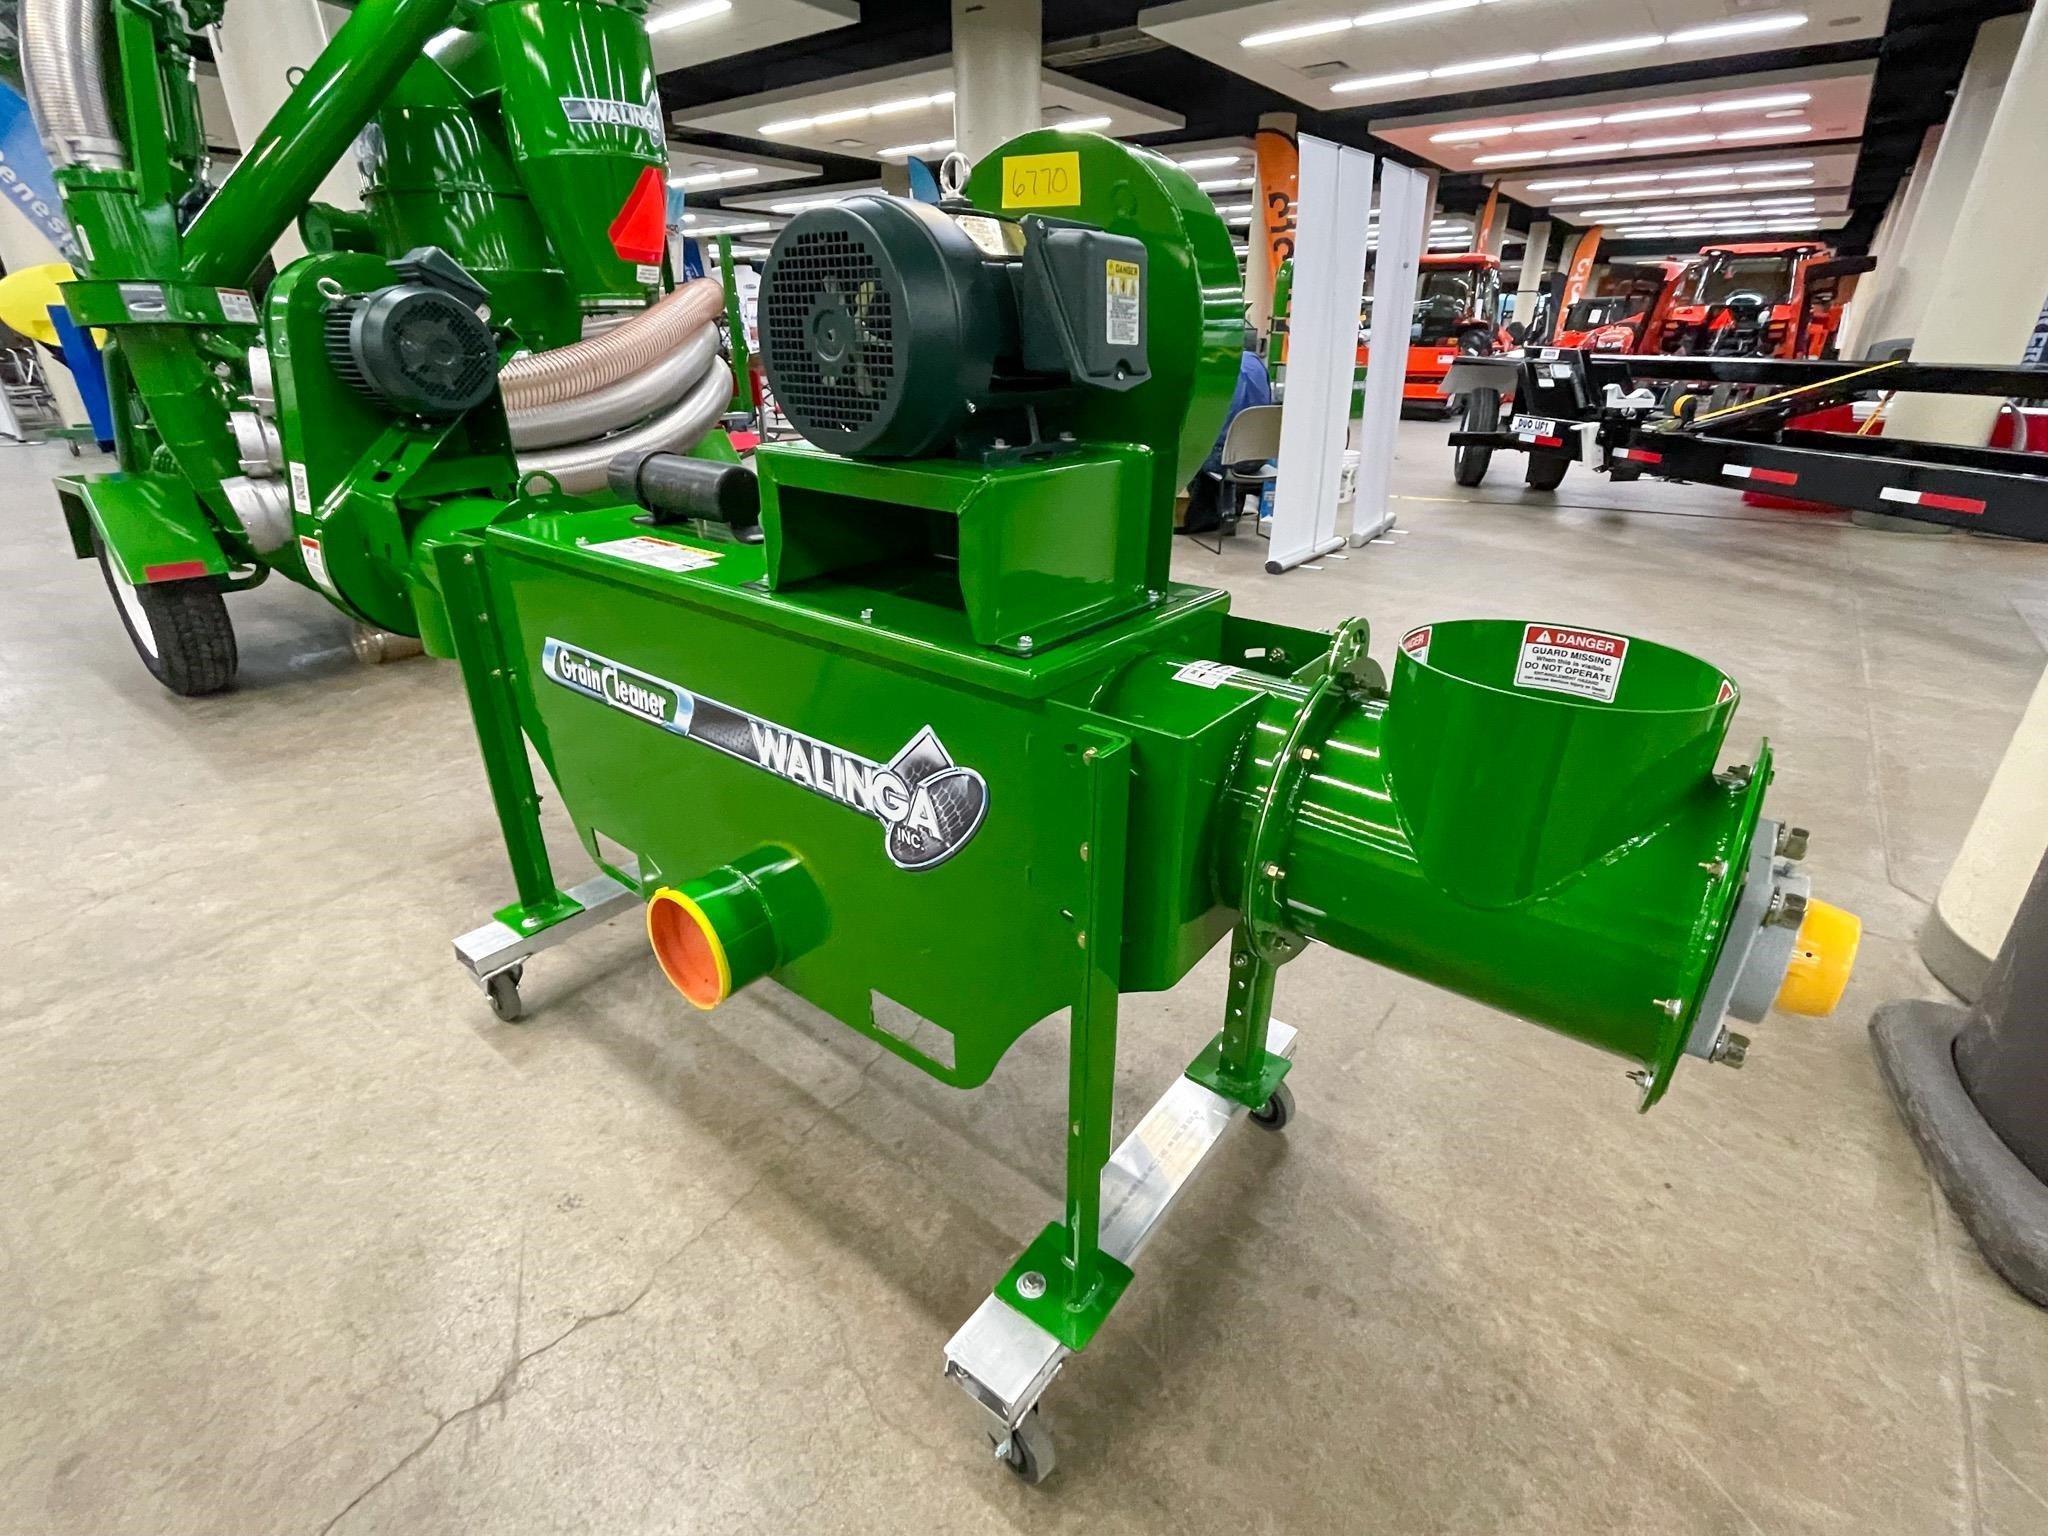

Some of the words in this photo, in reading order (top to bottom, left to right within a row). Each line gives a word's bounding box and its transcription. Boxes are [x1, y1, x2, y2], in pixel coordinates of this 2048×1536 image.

[1012, 167, 1068, 198] 6770
[1115, 263, 1138, 276] DANGER
[1517, 418, 1533, 430] DUO
[1556, 633, 1615, 653] DANGER
[1532, 646, 1568, 658] GUARD
[1570, 651, 1612, 666] MISSING
[1536, 655, 1557, 663] When
[1557, 658, 1571, 666] this
[1581, 662, 1604, 672] visible
[1524, 661, 1539, 669] DO
[1541, 663, 1562, 673] NOT
[1564, 666, 1612, 683] OPERATE
[559, 650, 601, 693] Grain
[601, 666, 667, 719] Cleaner
[750, 720, 945, 843] WALINGA
[897, 826, 926, 851] INC.
